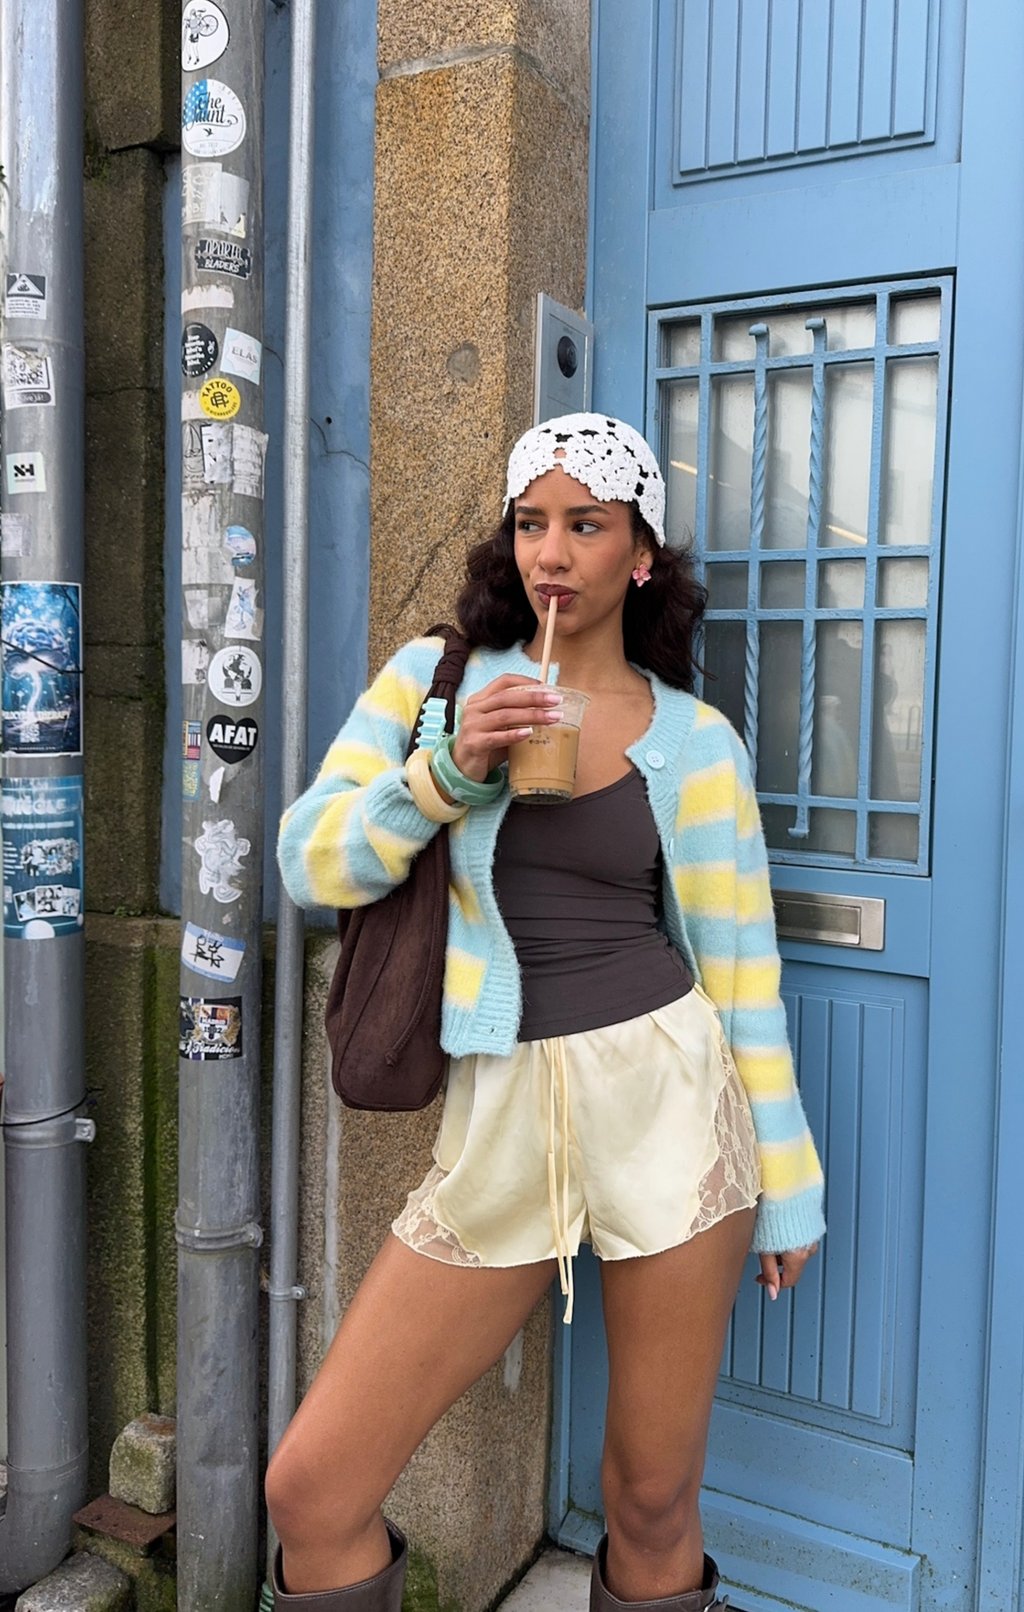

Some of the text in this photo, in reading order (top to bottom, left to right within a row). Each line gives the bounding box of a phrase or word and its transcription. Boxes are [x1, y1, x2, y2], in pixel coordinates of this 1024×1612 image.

[204, 259, 240, 272] BLADERS
[232, 346, 257, 364] ELAS
[202, 381, 233, 398] TATTOO
[209, 723, 257, 747] AFAT
